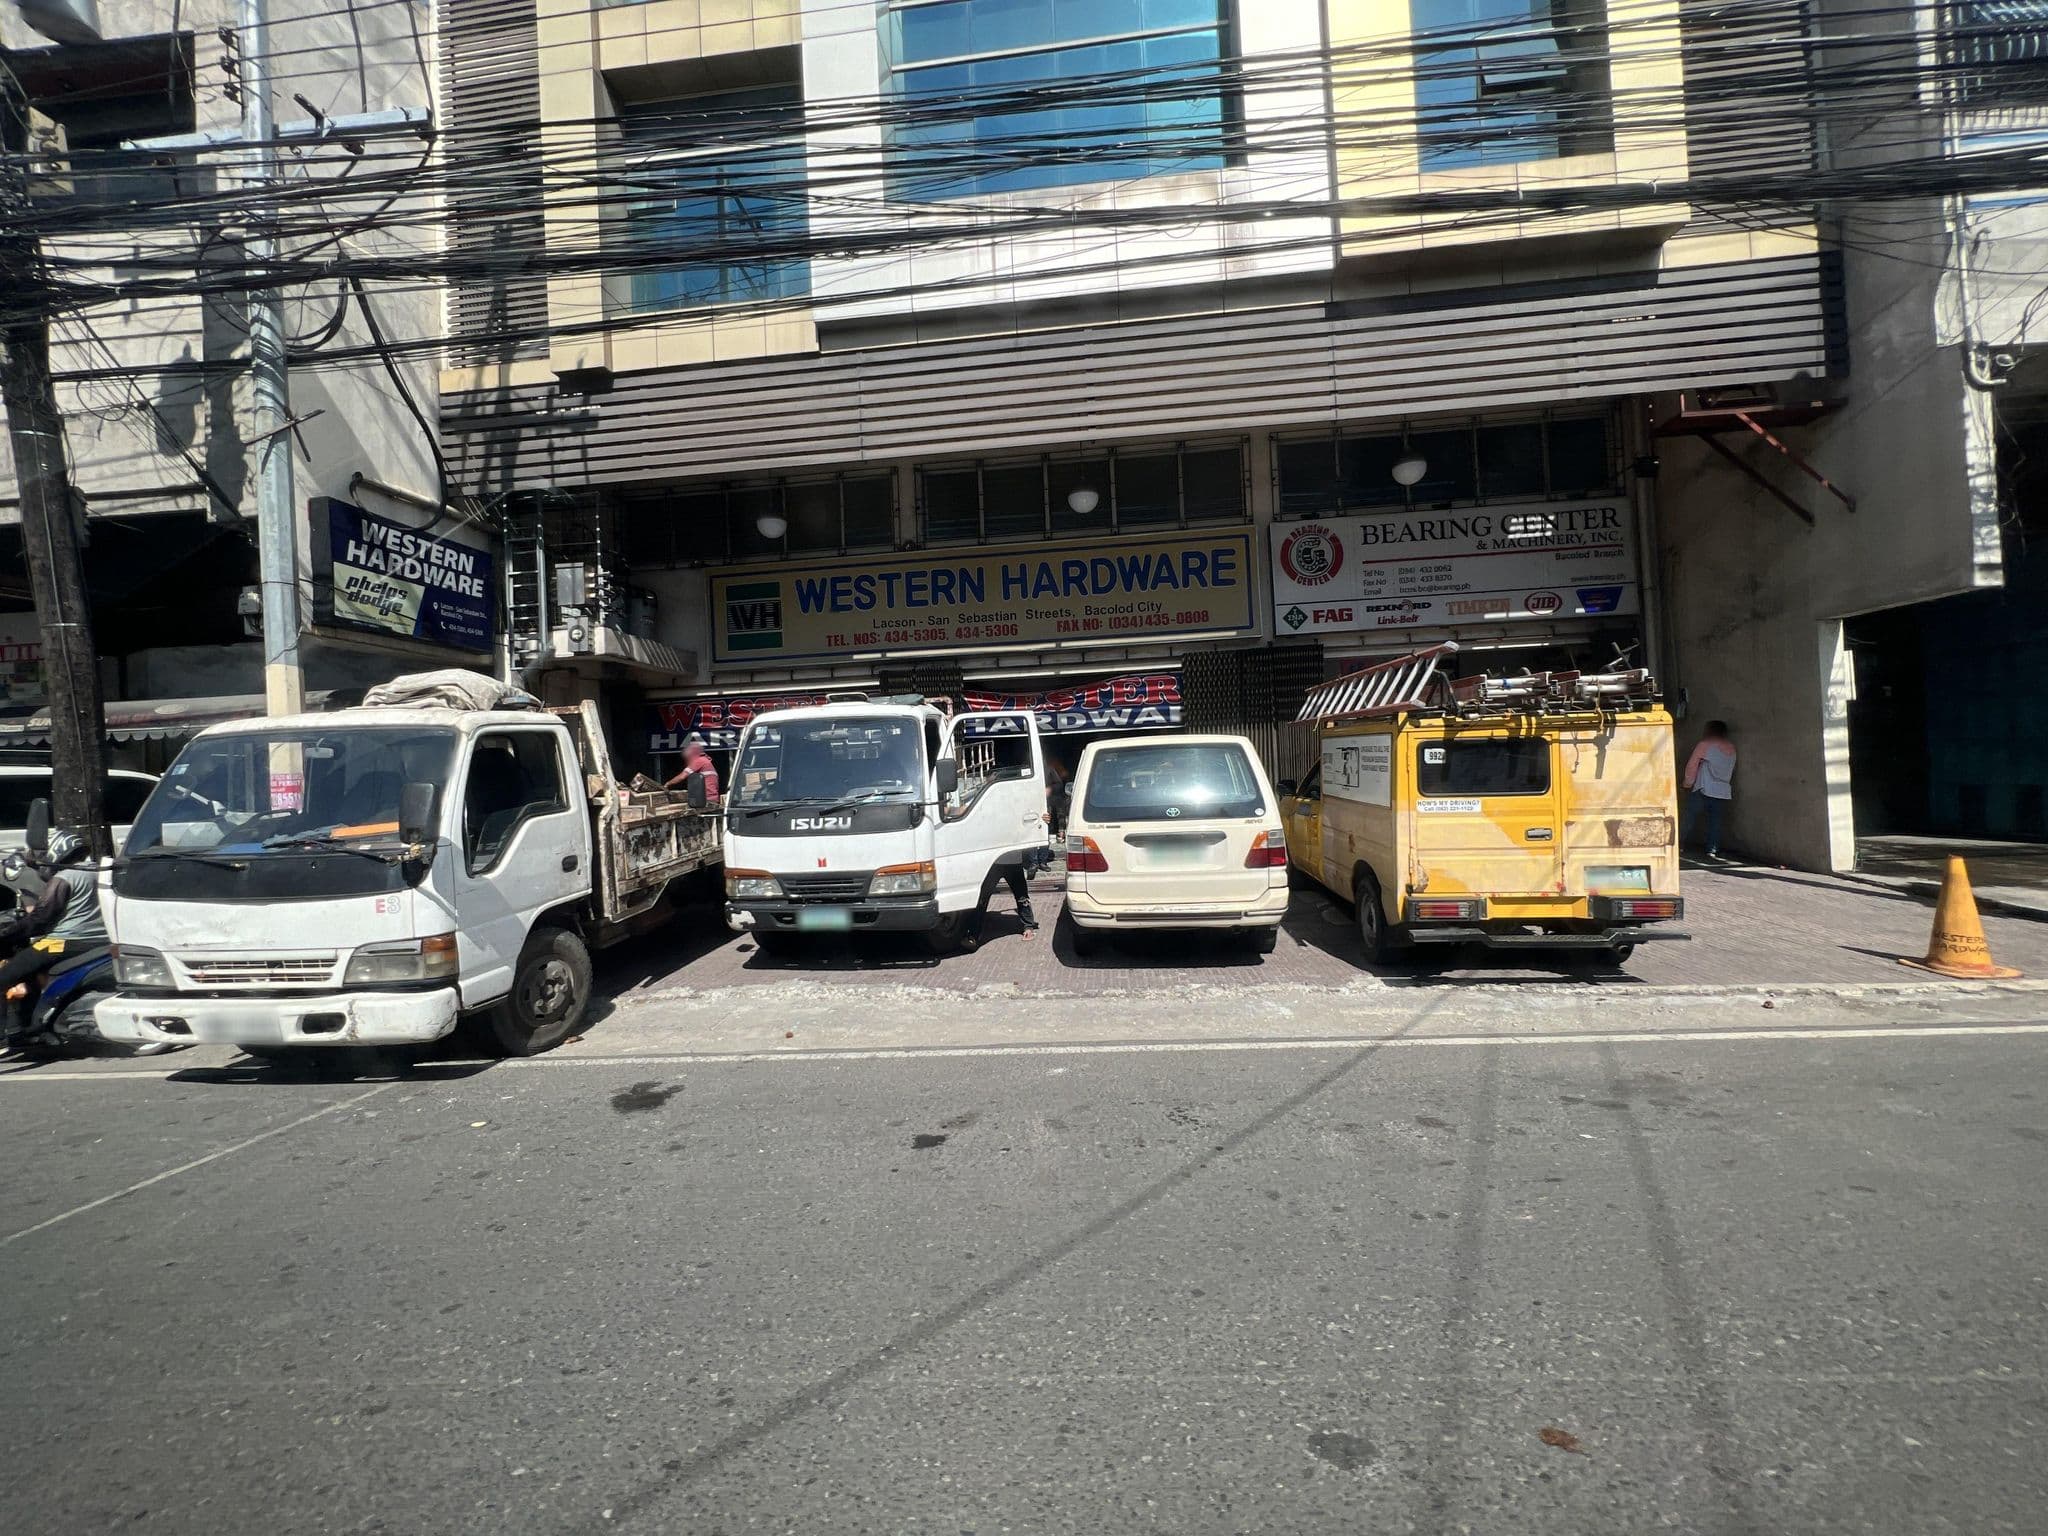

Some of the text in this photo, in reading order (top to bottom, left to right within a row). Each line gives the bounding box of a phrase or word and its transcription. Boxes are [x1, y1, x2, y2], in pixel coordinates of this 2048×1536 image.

[1360, 507, 1621, 545] BEARING CENTER
[361, 519, 474, 574] WESTERN
[1476, 540, 1488, 550] &
[347, 540, 484, 597] HARDWARE
[795, 549, 1236, 614] WESTERN HARDWARE
[345, 576, 408, 600] phelps
[347, 590, 404, 616] dodge
[873, 616, 916, 629] Lacson
[928, 615, 950, 627] San
[958, 610, 1017, 625] Sebastian
[1085, 603, 1134, 616] Bacolod
[1137, 601, 1162, 615] City
[1313, 608, 1353, 623] FAG
[826, 634, 849, 647] TEL.
[854, 632, 881, 645] NOS:
[955, 623, 1018, 640] 434-5306
[1056, 619, 1079, 633] FAX
[1082, 617, 1103, 631] NO:
[791, 816, 851, 830] ISUZU
